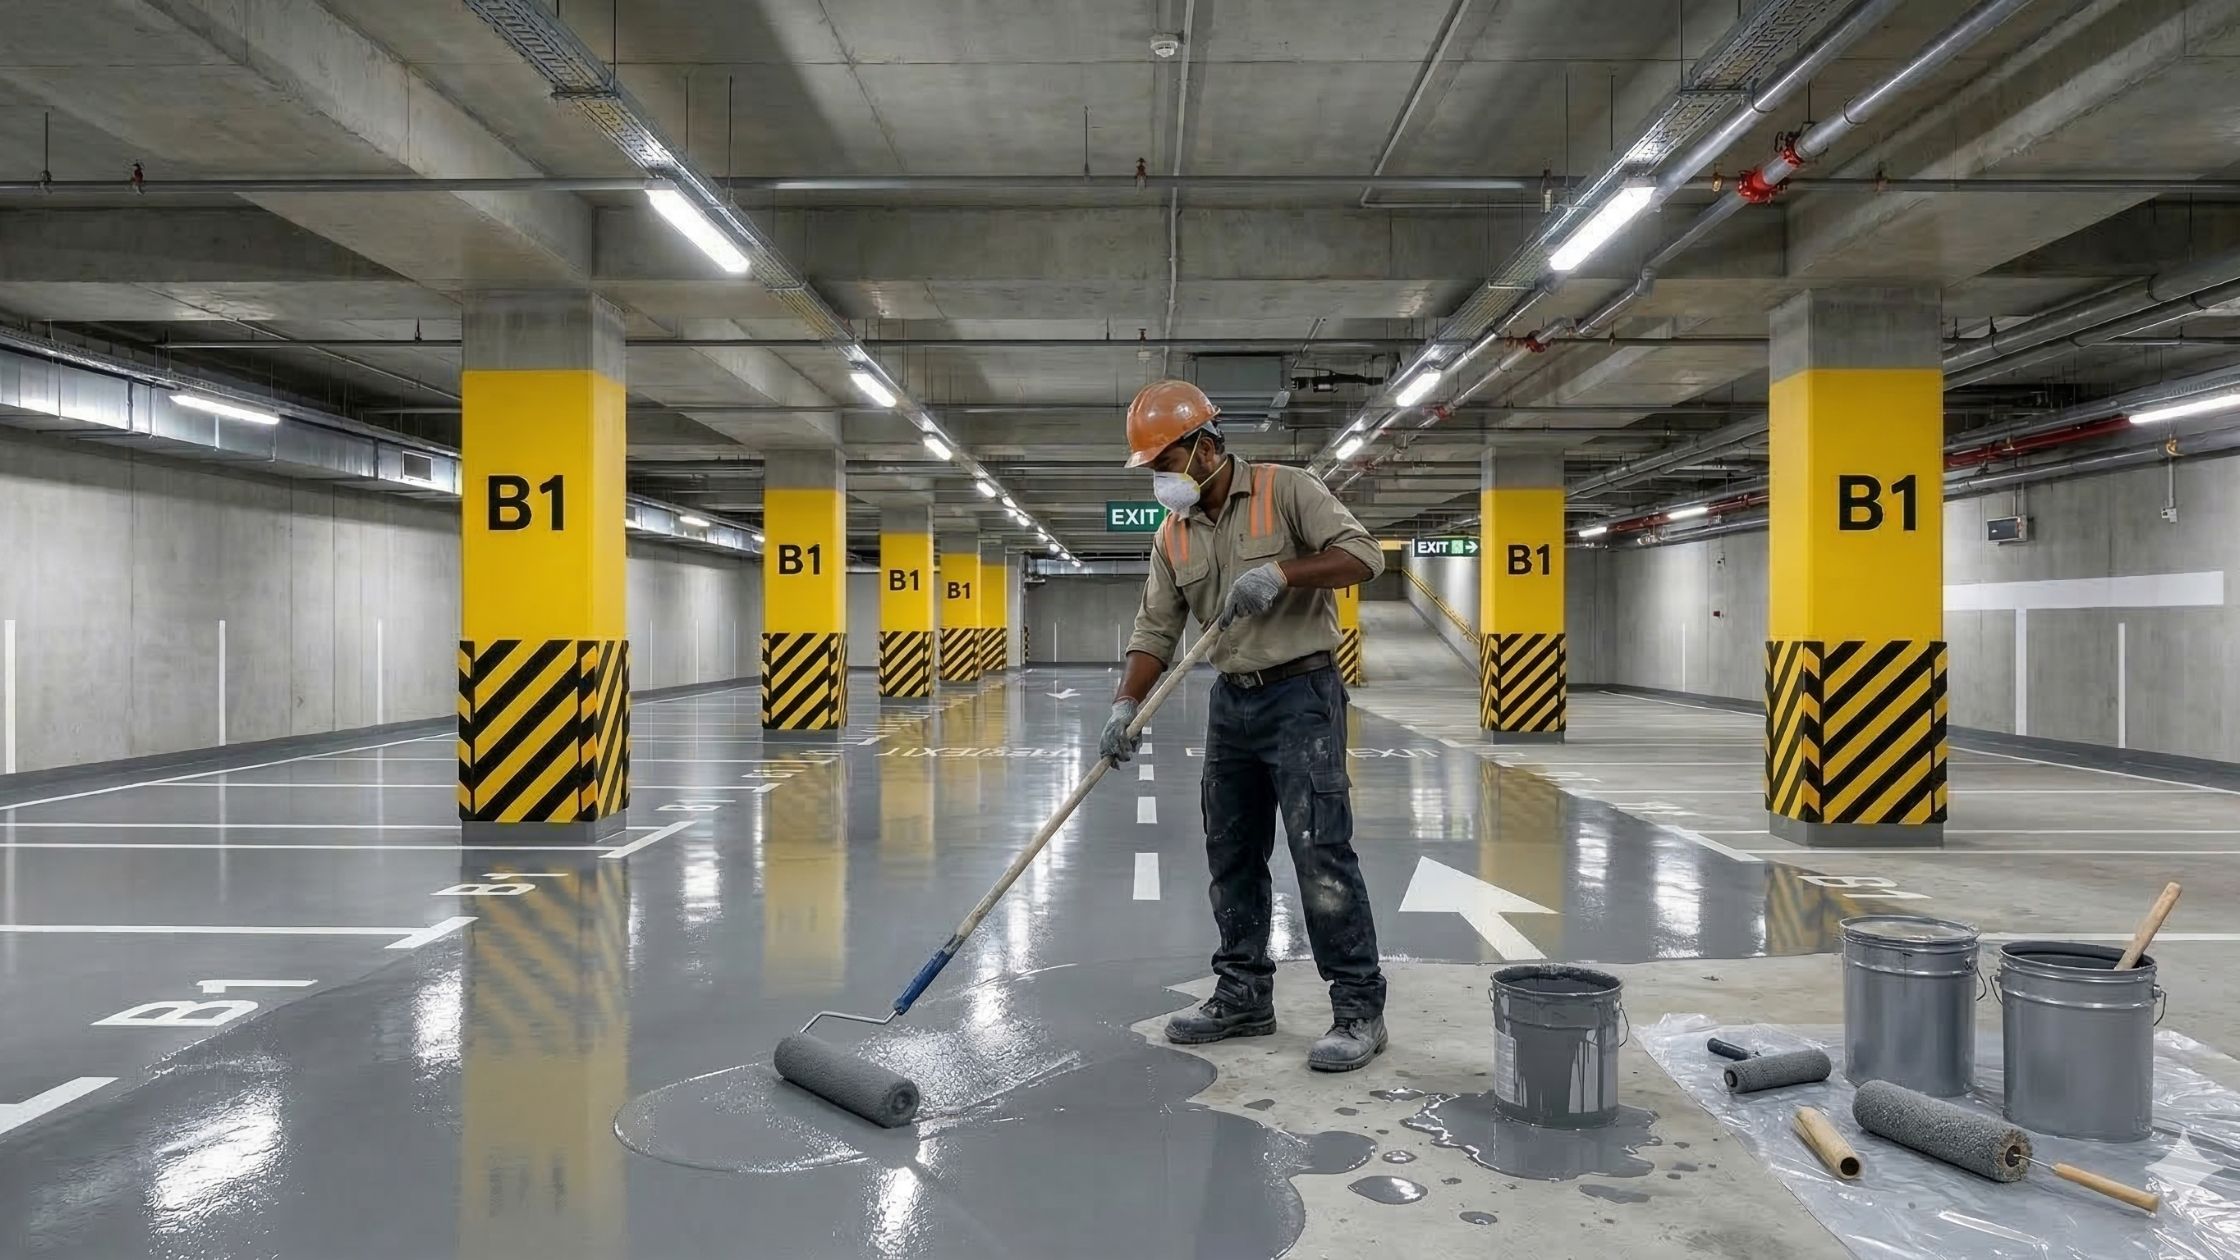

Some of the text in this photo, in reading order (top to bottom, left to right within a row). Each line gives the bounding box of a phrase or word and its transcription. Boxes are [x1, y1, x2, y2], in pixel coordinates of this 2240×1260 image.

[488, 474, 564, 531] B1
[1839, 474, 1917, 531] B1
[1111, 508, 1159, 525] EXIT
[778, 544, 821, 575] B1
[1417, 541, 1449, 554] EXIT
[1507, 544, 1551, 575] B1
[889, 569, 919, 591] B1
[947, 581, 971, 599] B1
[429, 872, 569, 896] B1
[1796, 875, 1933, 899] B1
[91, 979, 318, 1026] B1
